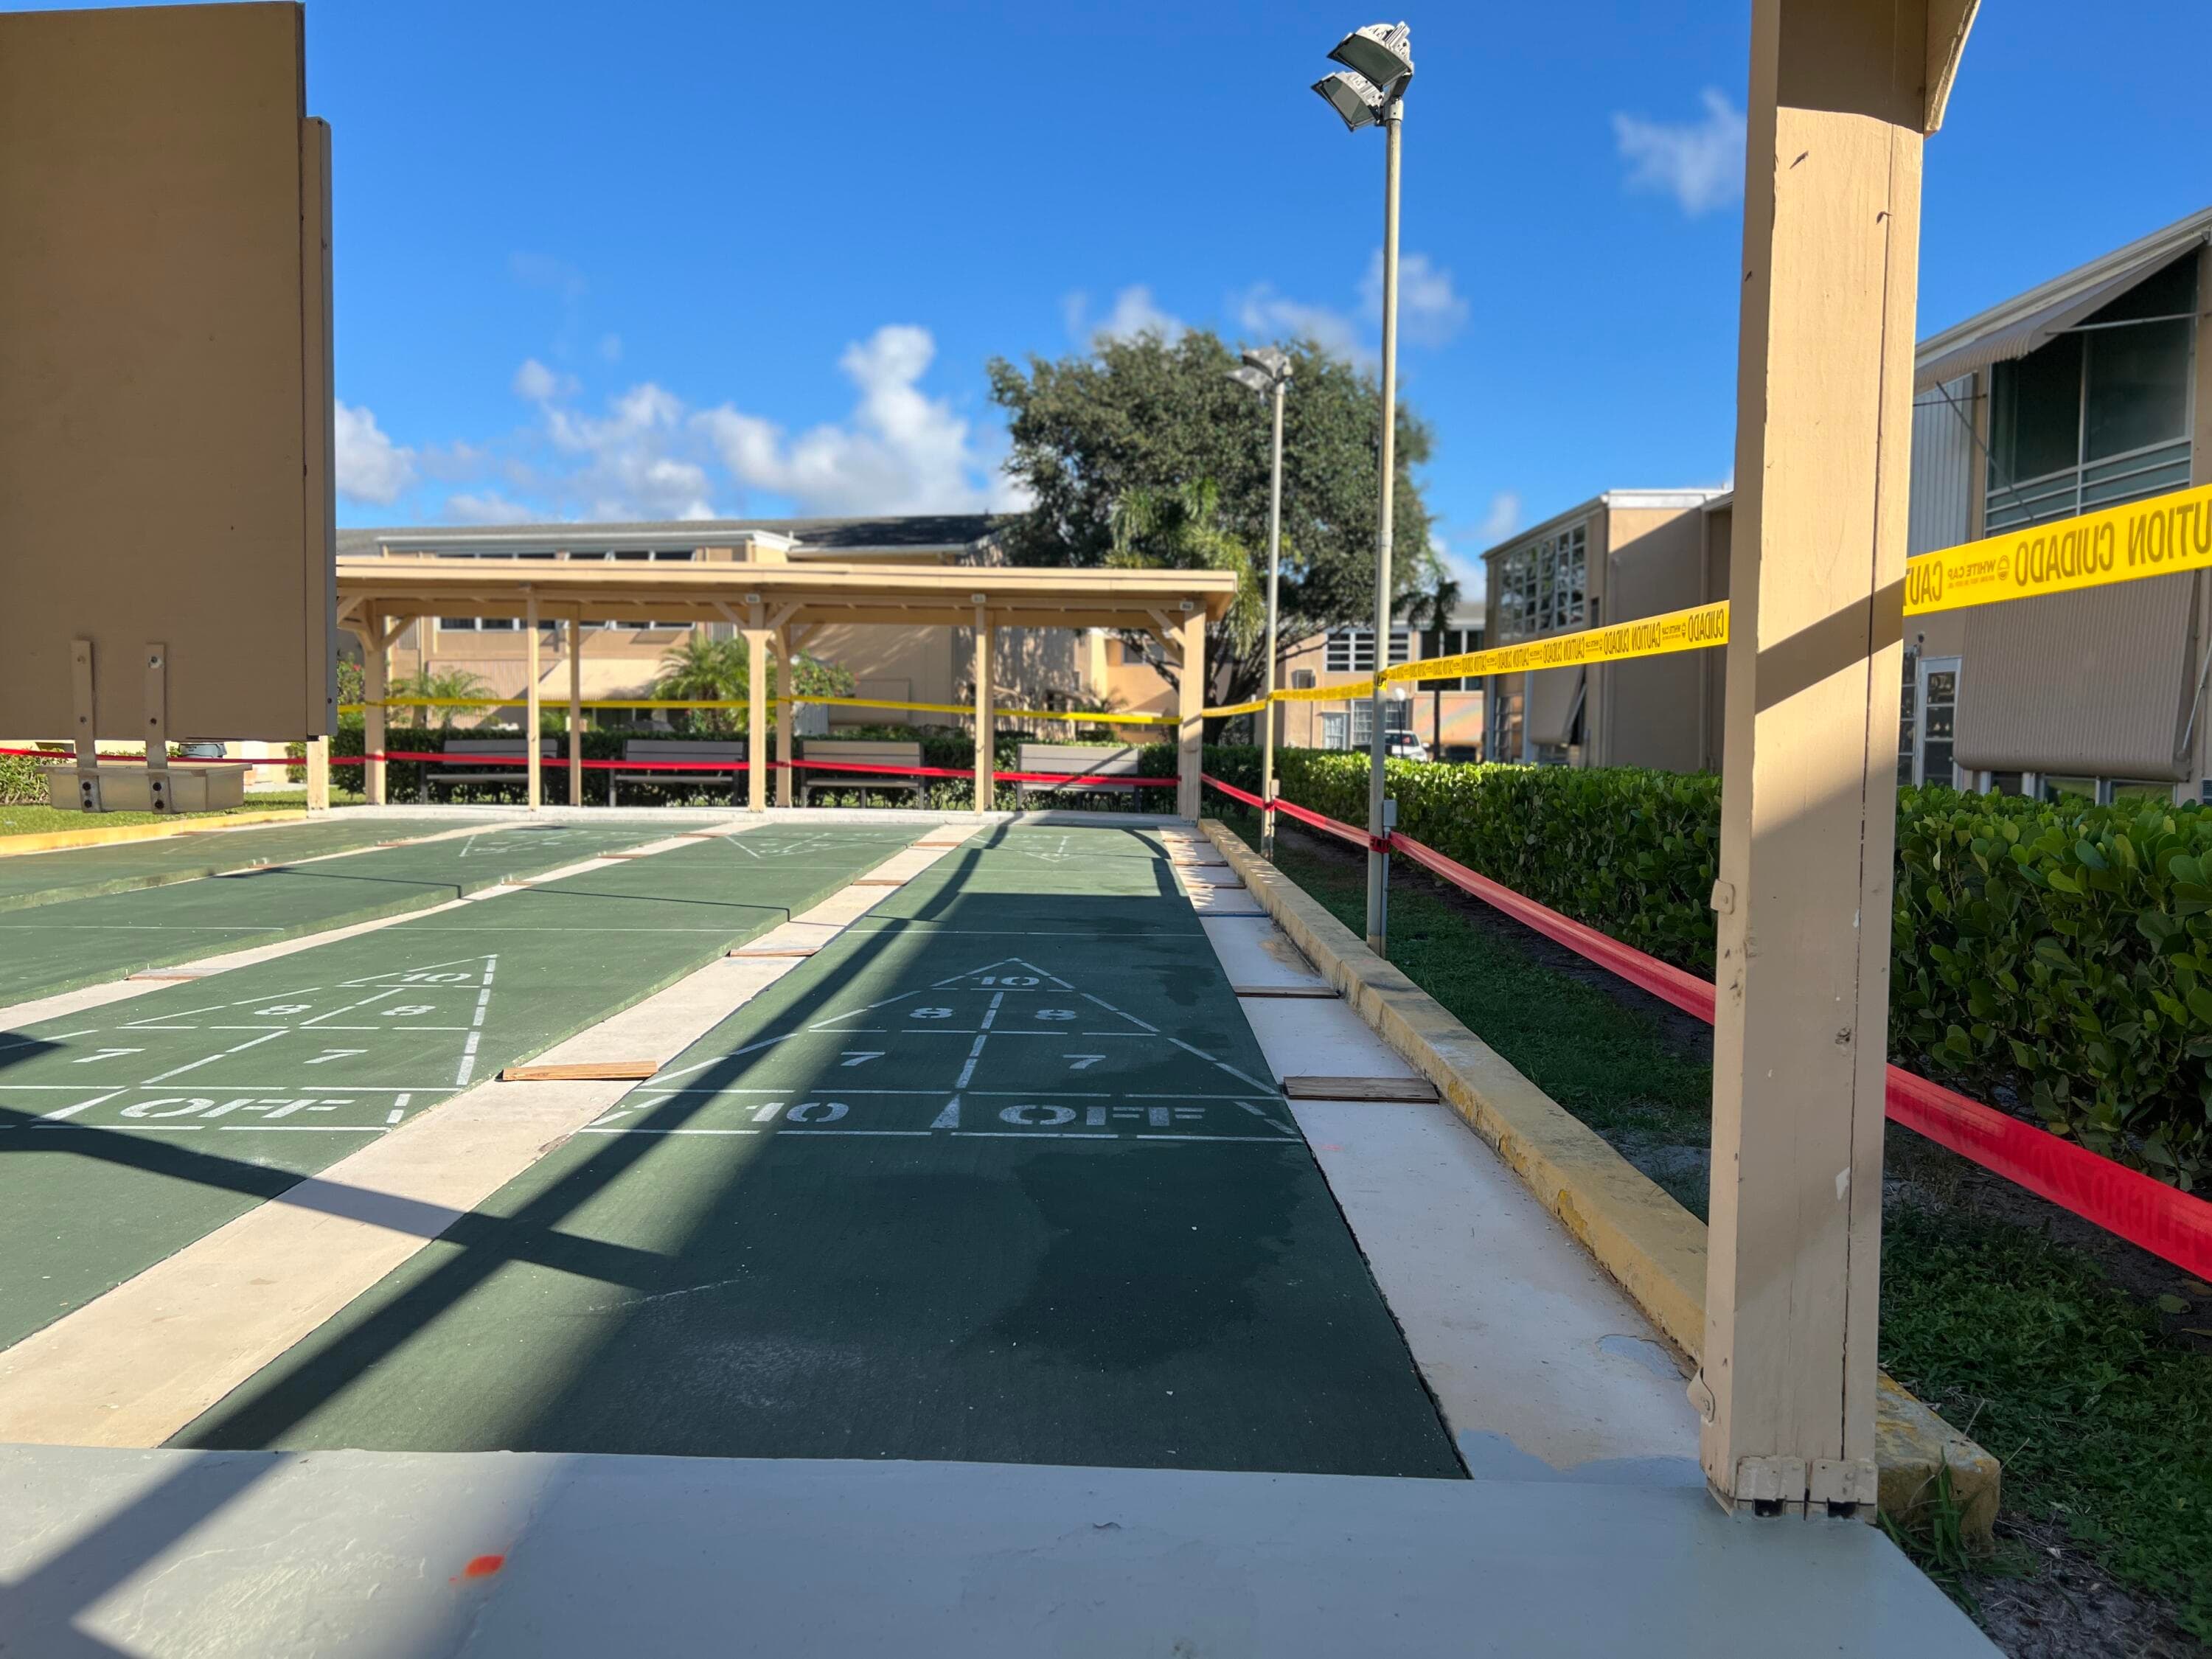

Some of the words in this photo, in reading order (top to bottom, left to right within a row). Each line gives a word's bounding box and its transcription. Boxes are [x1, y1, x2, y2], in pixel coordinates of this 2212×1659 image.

[400, 973, 472, 982] 10
[973, 976, 1040, 986] 10
[254, 1004, 312, 1015] 8
[380, 1005, 437, 1016] 8
[909, 1007, 953, 1019] 8
[1034, 1009, 1077, 1020] 8
[72, 1048, 146, 1063] 7
[303, 1049, 369, 1064] 7
[841, 1051, 886, 1066] 7
[1062, 1054, 1106, 1069] 7
[120, 1098, 356, 1118] OFF
[745, 1102, 849, 1122] 10
[999, 1105, 1206, 1127] OFF
